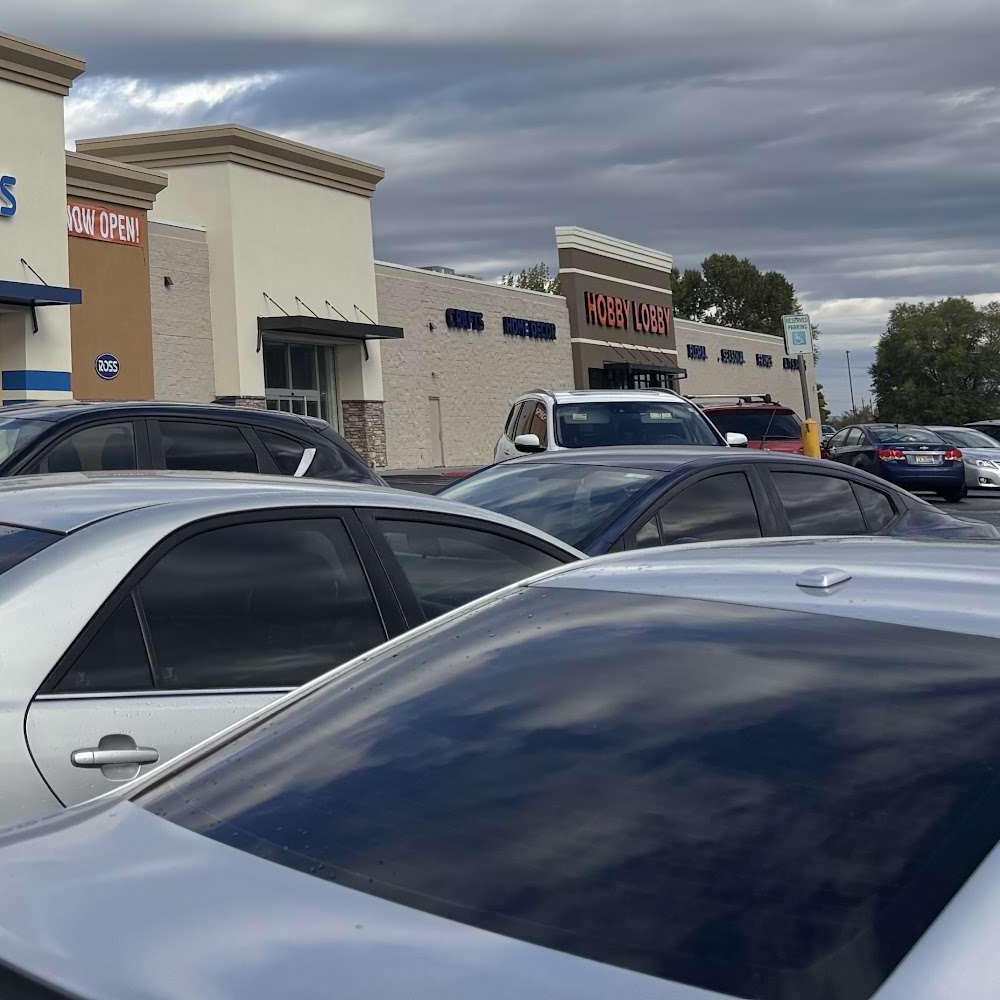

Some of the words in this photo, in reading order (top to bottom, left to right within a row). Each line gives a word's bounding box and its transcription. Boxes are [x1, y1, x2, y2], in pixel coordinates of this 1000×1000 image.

[100, 210, 140, 244] OPEN!
[445, 308, 485, 332] CRAFTS
[584, 290, 630, 330] HOBBY
[631, 301, 670, 336] LOBBY
[502, 316, 529, 337] HOME
[529, 320, 557, 341] DECOR
[98, 359, 118, 373] ROSS
